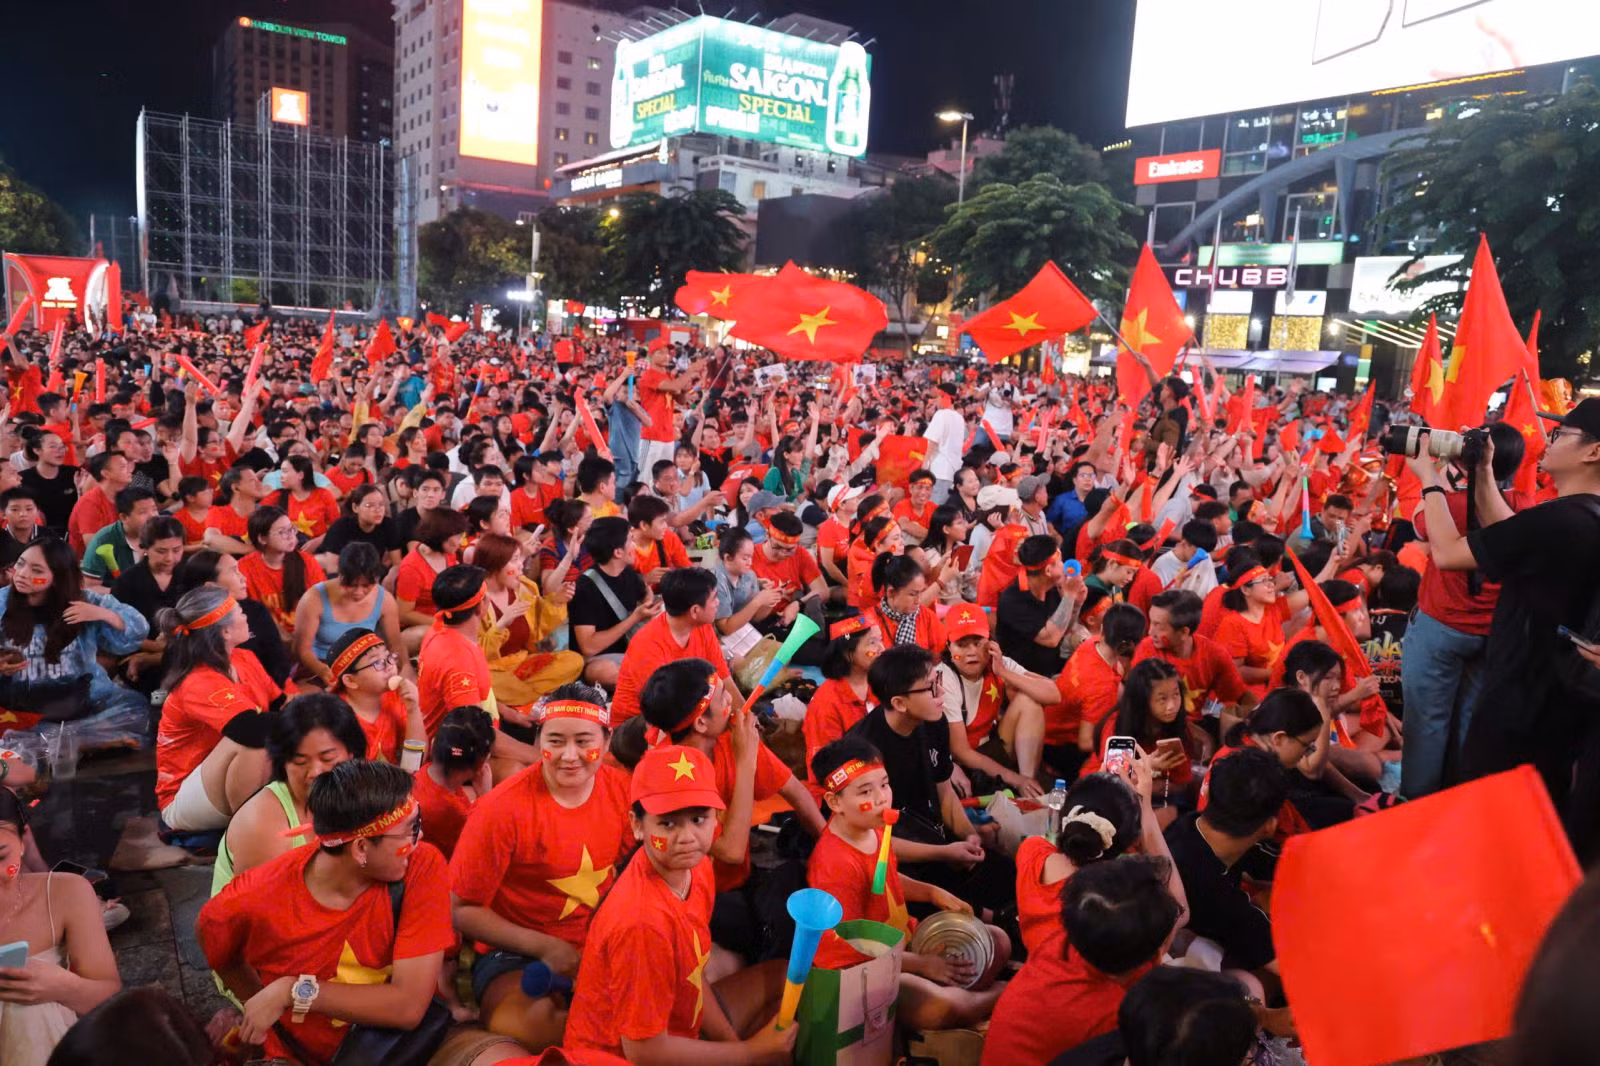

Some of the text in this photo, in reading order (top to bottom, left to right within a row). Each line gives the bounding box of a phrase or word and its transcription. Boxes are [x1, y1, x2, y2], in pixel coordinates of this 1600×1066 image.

[316, 31, 346, 45] TOWER
[739, 93, 816, 124] SPECIAL
[1174, 268, 1288, 286] CHUBB
[378, 807, 405, 829] NAM
